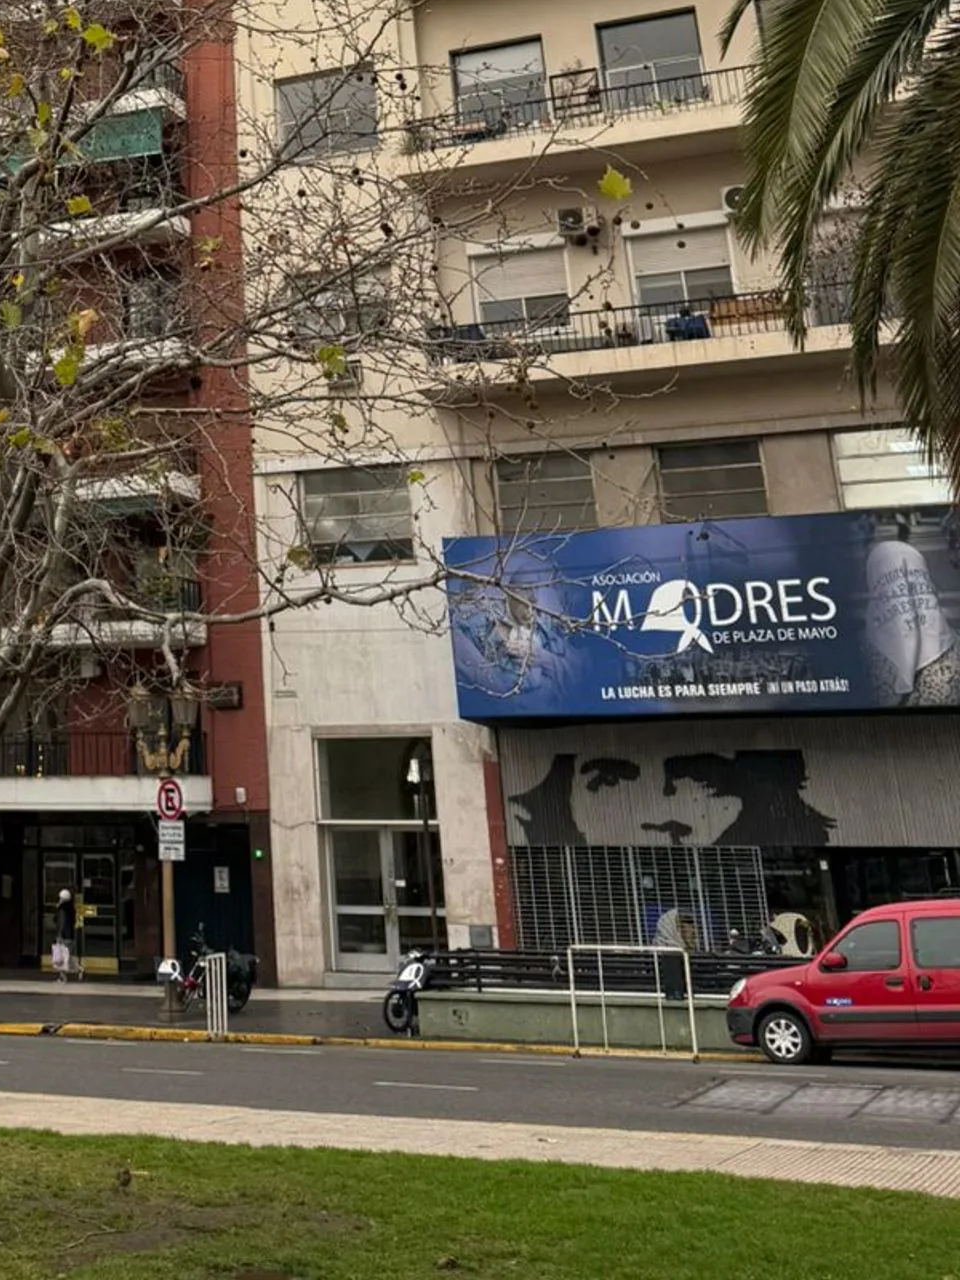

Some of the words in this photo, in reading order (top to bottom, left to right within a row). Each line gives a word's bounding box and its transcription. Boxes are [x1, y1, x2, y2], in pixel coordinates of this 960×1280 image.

[592, 571, 661, 586] ASOCIACIÓN
[713, 632, 731, 644] DE
[733, 631, 775, 643] PLAZA
[777, 628, 796, 640] DE
[799, 626, 837, 639] MAYO
[601, 687, 616, 700] LA
[618, 686, 656, 699] LUCHA
[658, 685, 672, 697] ES
[674, 684, 706, 697] PARA
[708, 681, 760, 696] SIEMPRE
[795, 680, 818, 693] PASO
